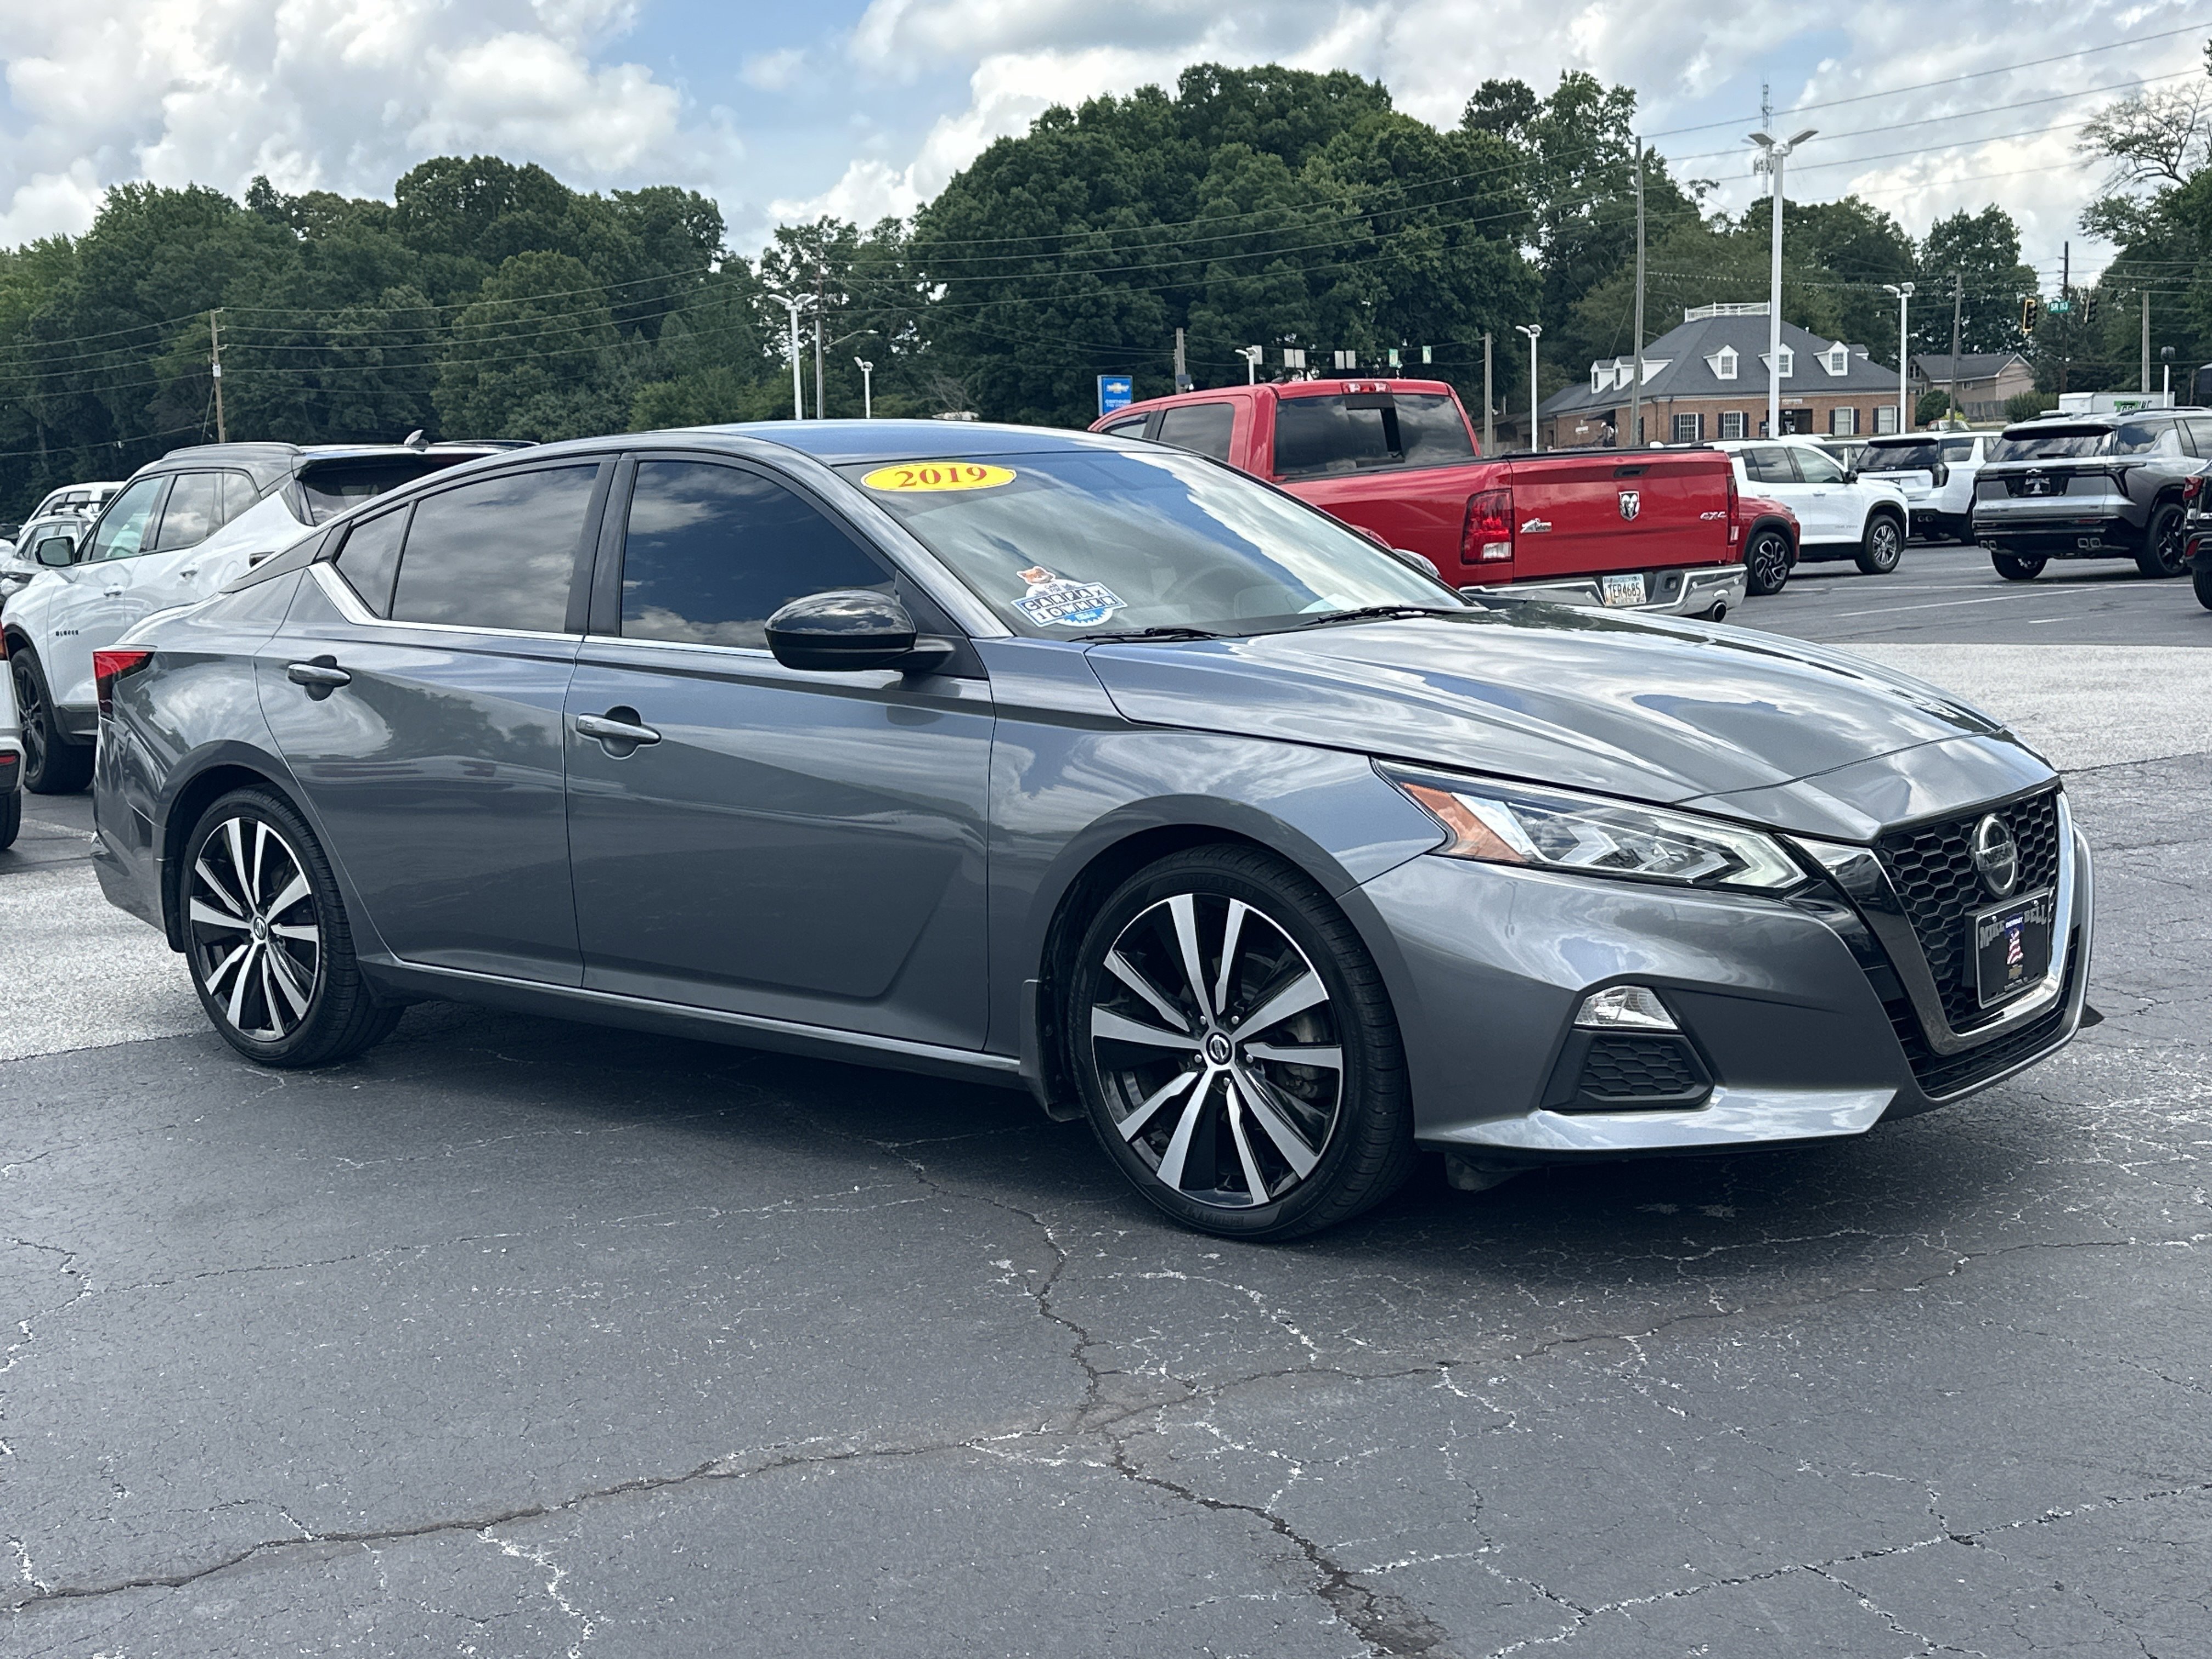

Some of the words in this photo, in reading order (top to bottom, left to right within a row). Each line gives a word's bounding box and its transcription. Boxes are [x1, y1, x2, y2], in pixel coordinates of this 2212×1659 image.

[895, 466, 987, 487] 2019
[1024, 588, 1104, 611] CARFAX
[1037, 612, 1047, 620] 1
[1046, 596, 1118, 618] OWNER
[1979, 920, 2005, 949] MIKE
[2024, 905, 2047, 925] BELL
